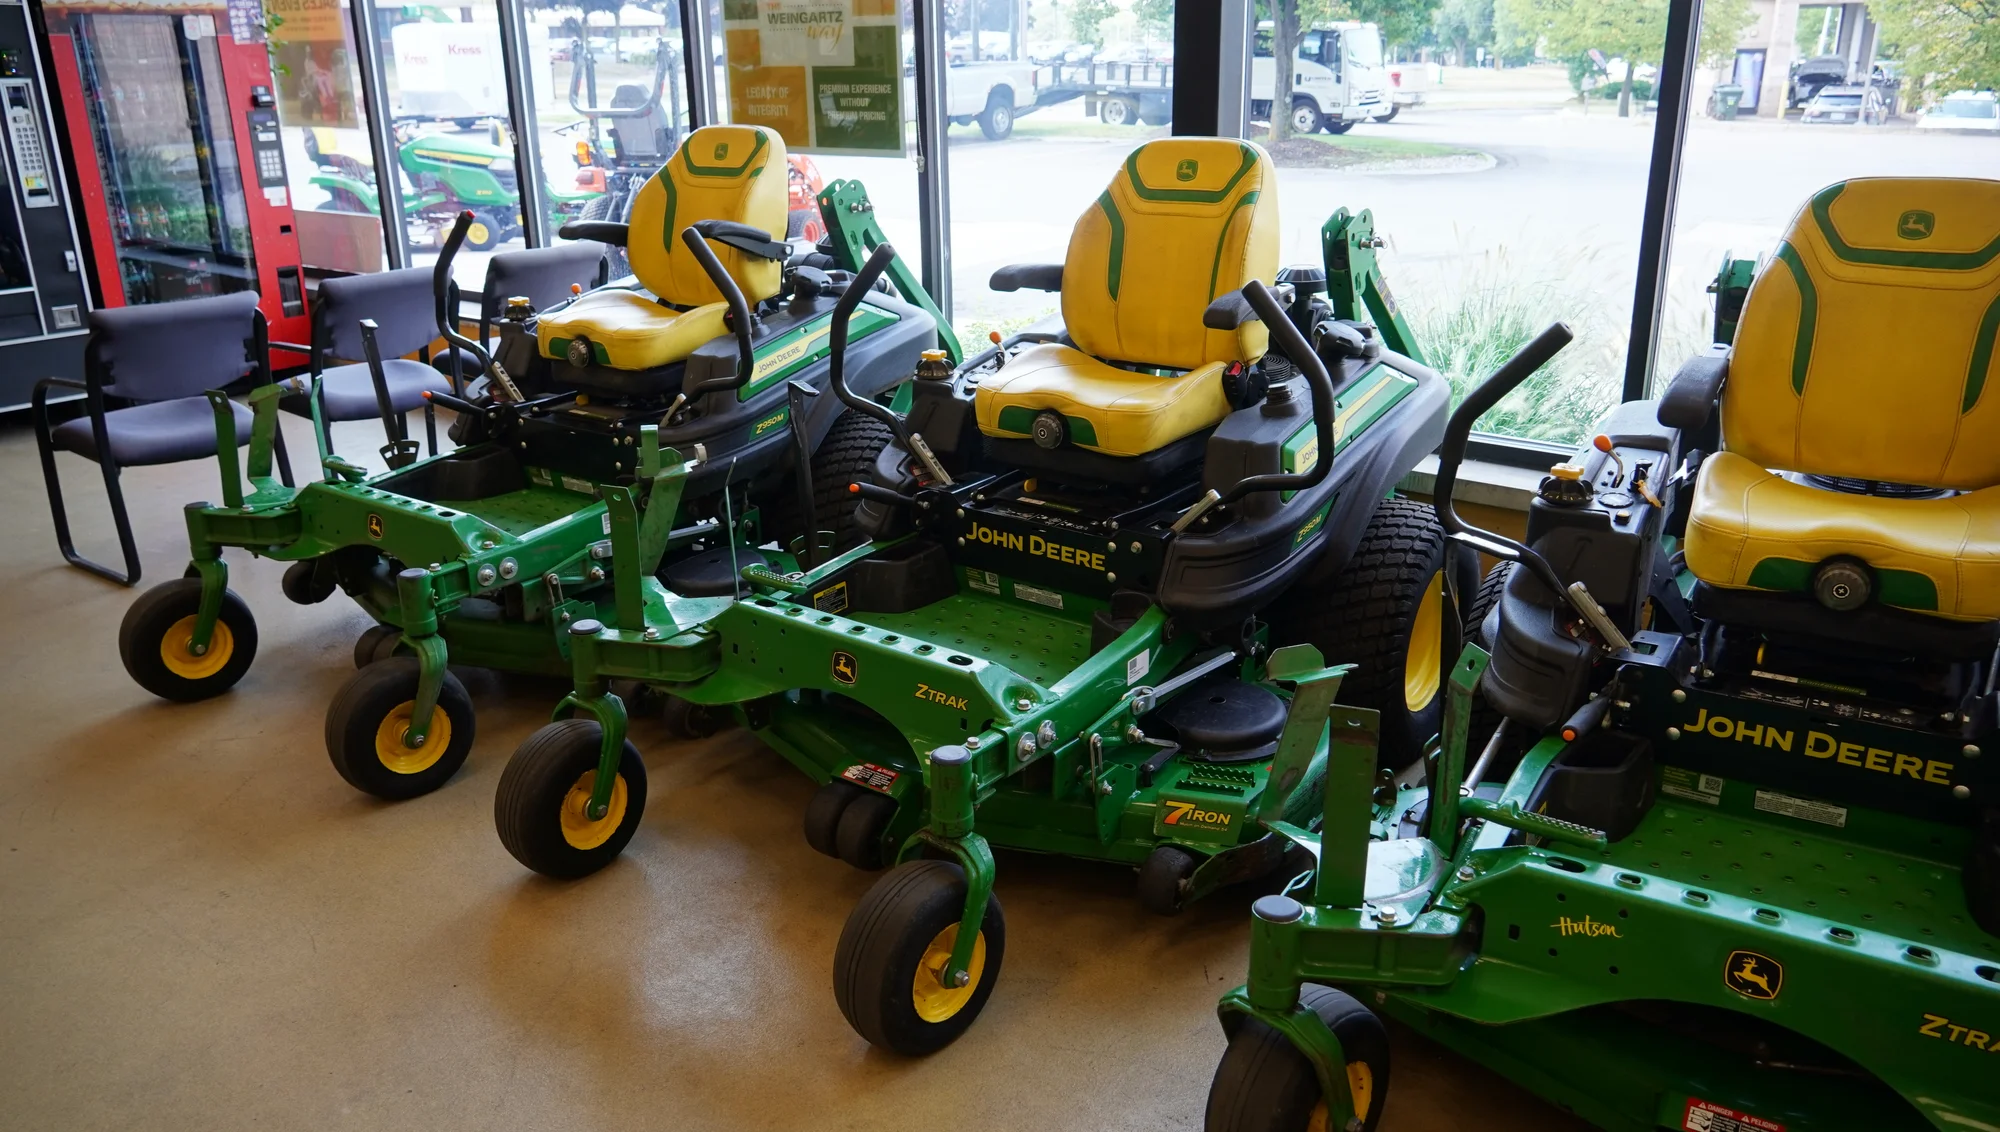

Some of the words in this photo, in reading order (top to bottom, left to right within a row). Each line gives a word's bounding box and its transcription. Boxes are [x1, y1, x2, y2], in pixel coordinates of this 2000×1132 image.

[767, 11, 843, 25] WEINGARTZ
[447, 44, 482, 55] Kress
[746, 86, 776, 100] LEGACY
[779, 87, 789, 98] OF
[819, 84, 849, 94] PREMIUM
[851, 84, 892, 94] EXPERIENCE
[840, 98, 869, 107] WITHOUT
[748, 104, 789, 116] INTEGRITY
[827, 111, 858, 121] PREMIUM
[859, 111, 886, 121] PRICING
[759, 359, 777, 373] JOHN
[777, 346, 800, 363] DEERE
[756, 413, 784, 435] Z950M
[966, 521, 1024, 552] JOHN
[1030, 534, 1106, 571] DEERE
[915, 683, 969, 711] ZTRAK
[1683, 708, 1794, 752] JOHN
[1804, 730, 1954, 785] DEERE
[1550, 914, 1624, 938] Hutson
[1707, 1104, 1734, 1117] DANGER
[1750, 1117, 1778, 1131] PELIGRO
